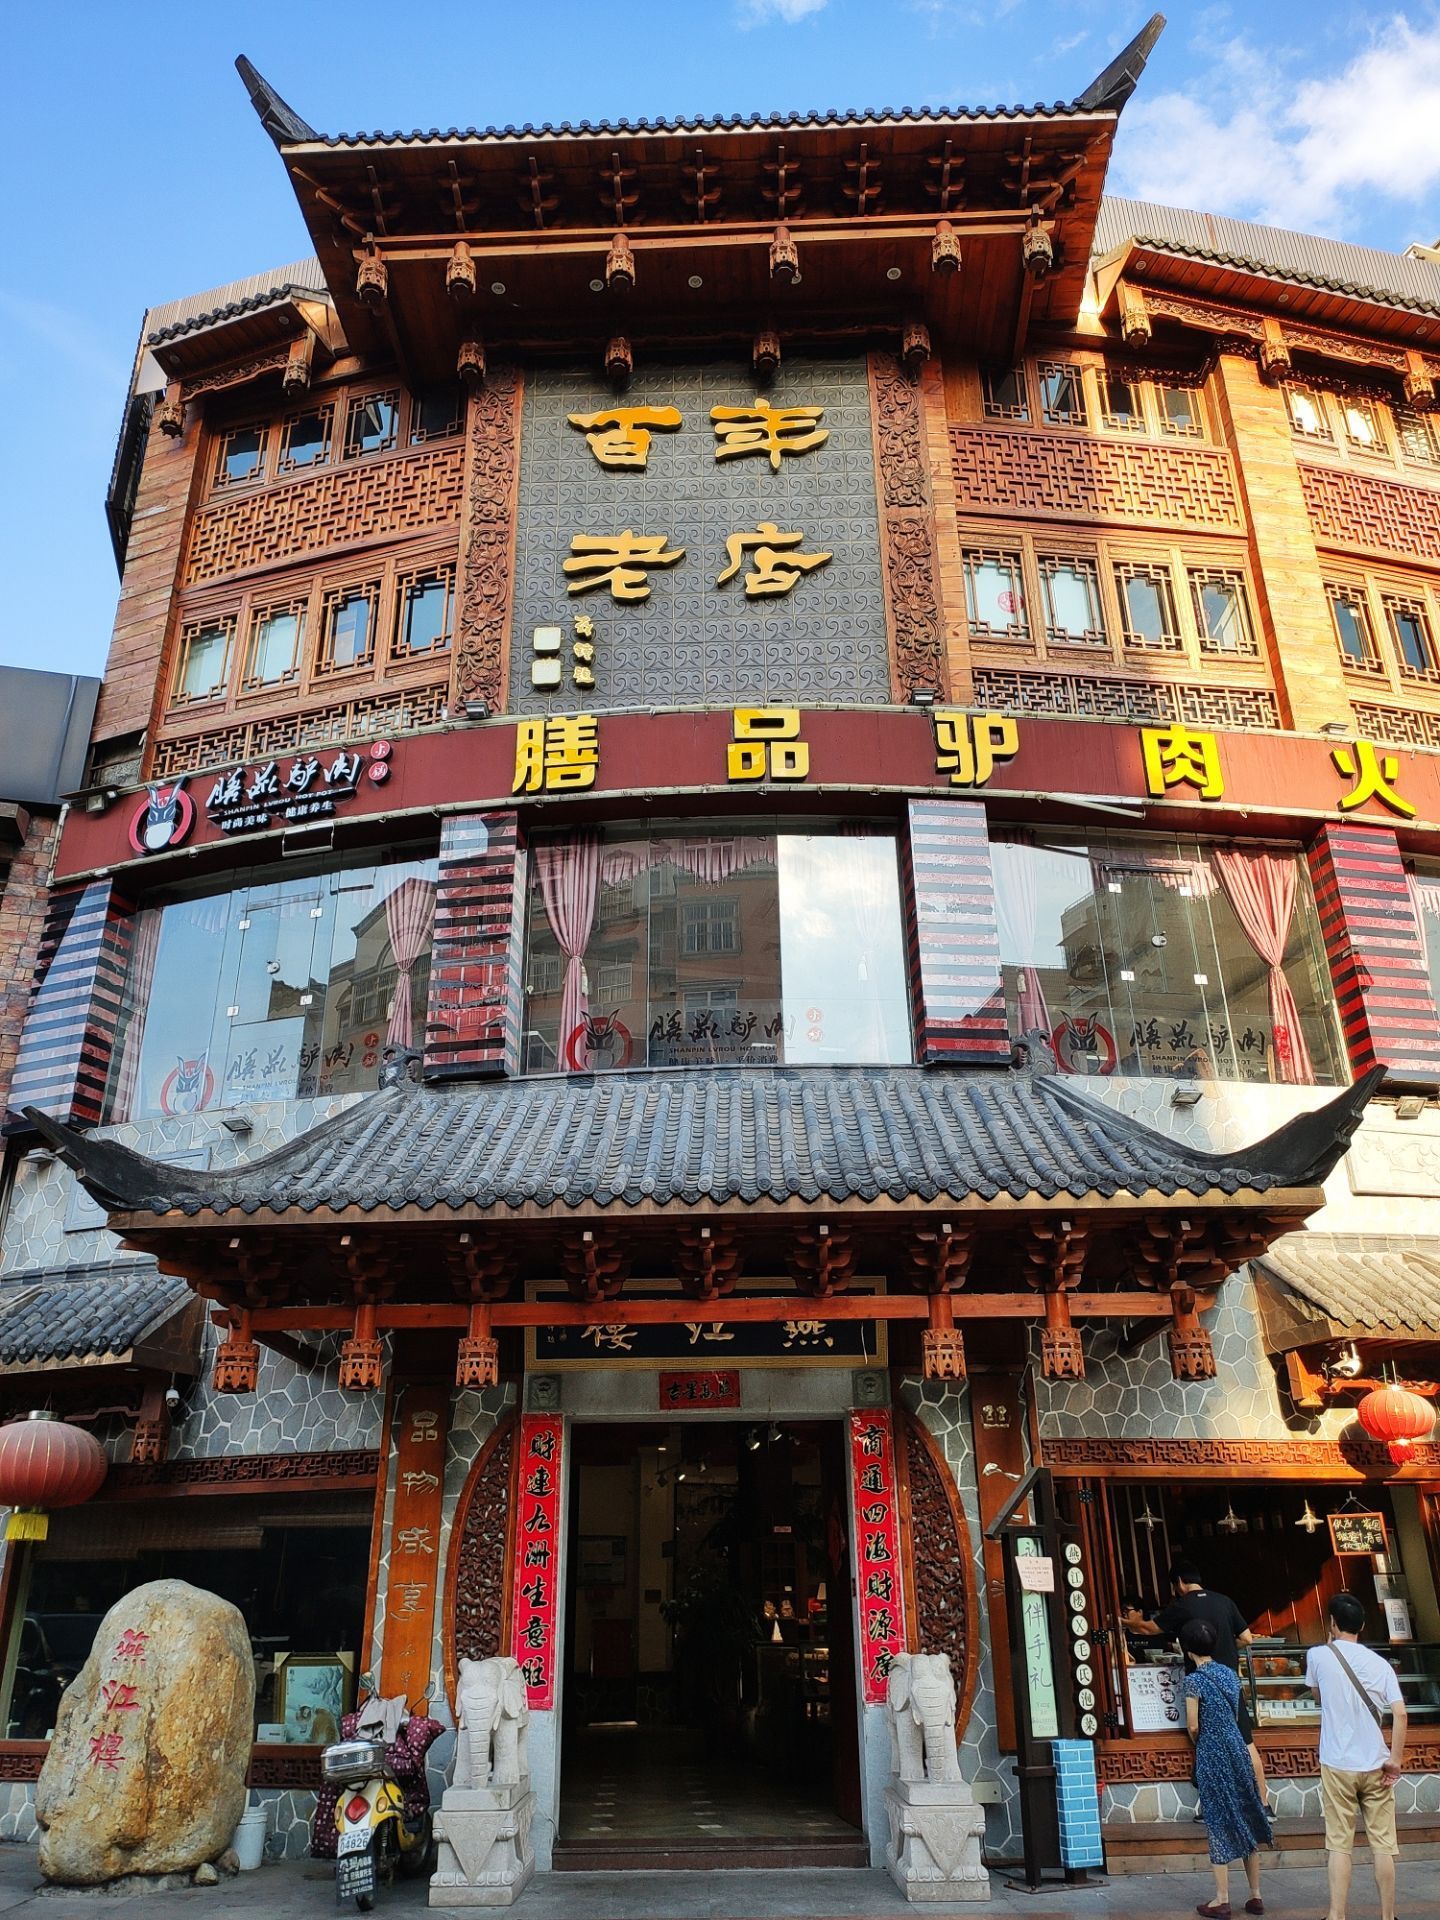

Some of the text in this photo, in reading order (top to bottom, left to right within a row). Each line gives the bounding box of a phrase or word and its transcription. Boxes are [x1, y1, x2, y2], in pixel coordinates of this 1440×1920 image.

[566, 398, 830, 473] 百年
[563, 522, 833, 601] 老店
[223, 803, 260, 816] SHANPIN
[295, 792, 315, 800] HOT
[1021, 1541, 1052, 1691] 永伴手礼
[340, 1836, 369, 1853] 04826
